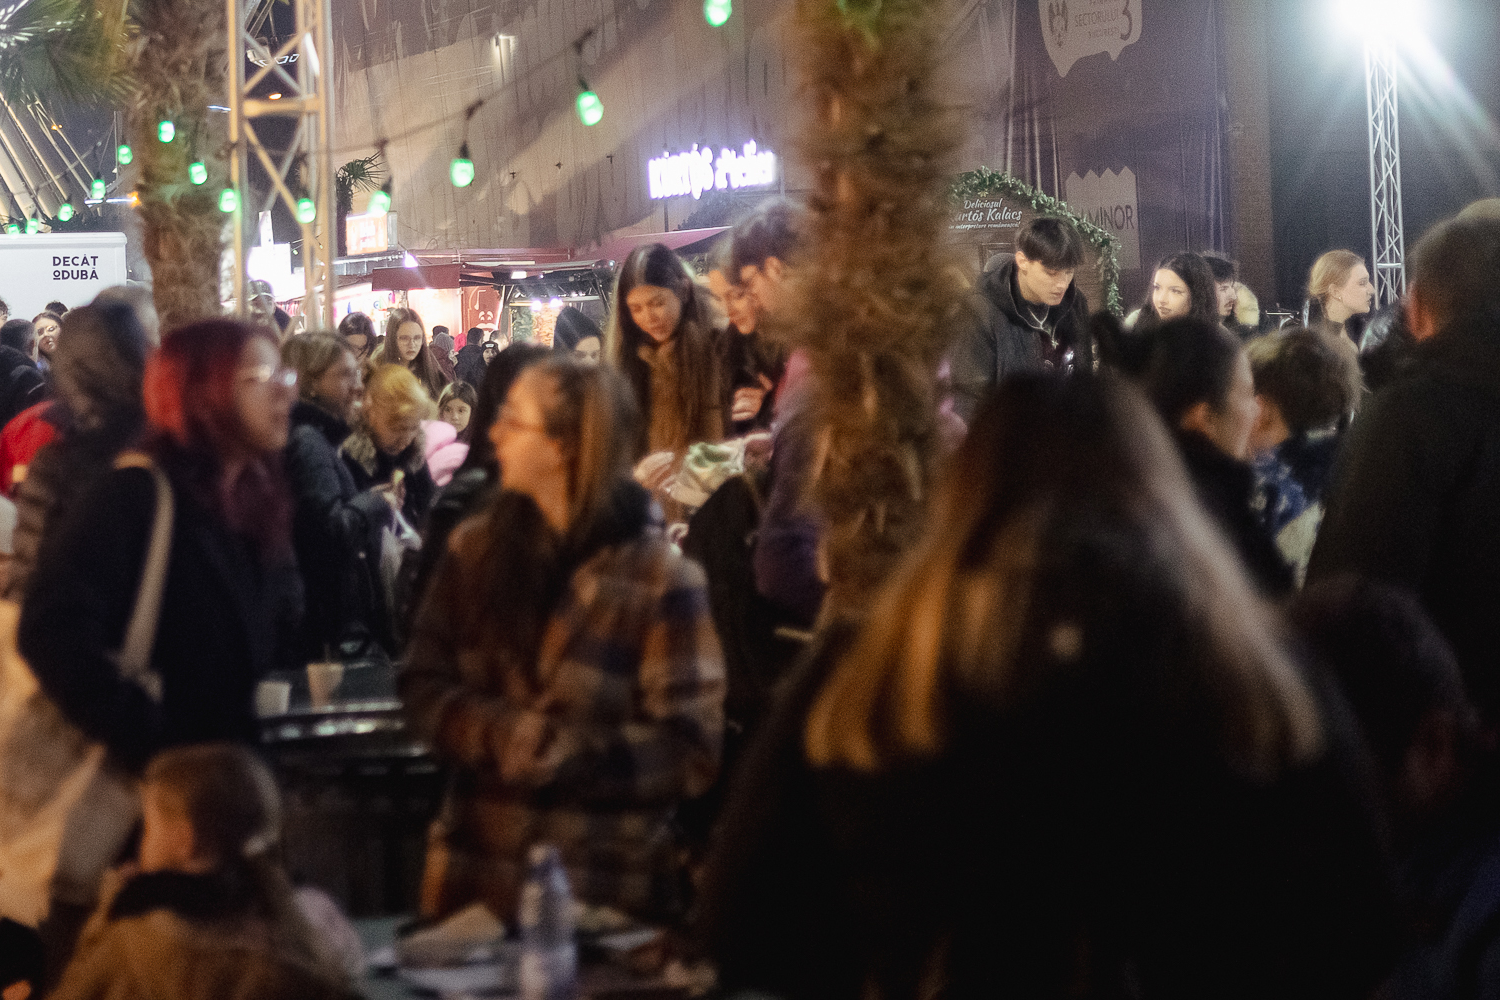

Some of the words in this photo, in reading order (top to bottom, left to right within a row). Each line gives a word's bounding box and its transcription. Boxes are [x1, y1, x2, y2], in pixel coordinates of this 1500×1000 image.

[1074, 8, 1119, 28] SECTORULUI
[964, 198, 1003, 209] Deliciosul
[986, 207, 1023, 221] Kalács
